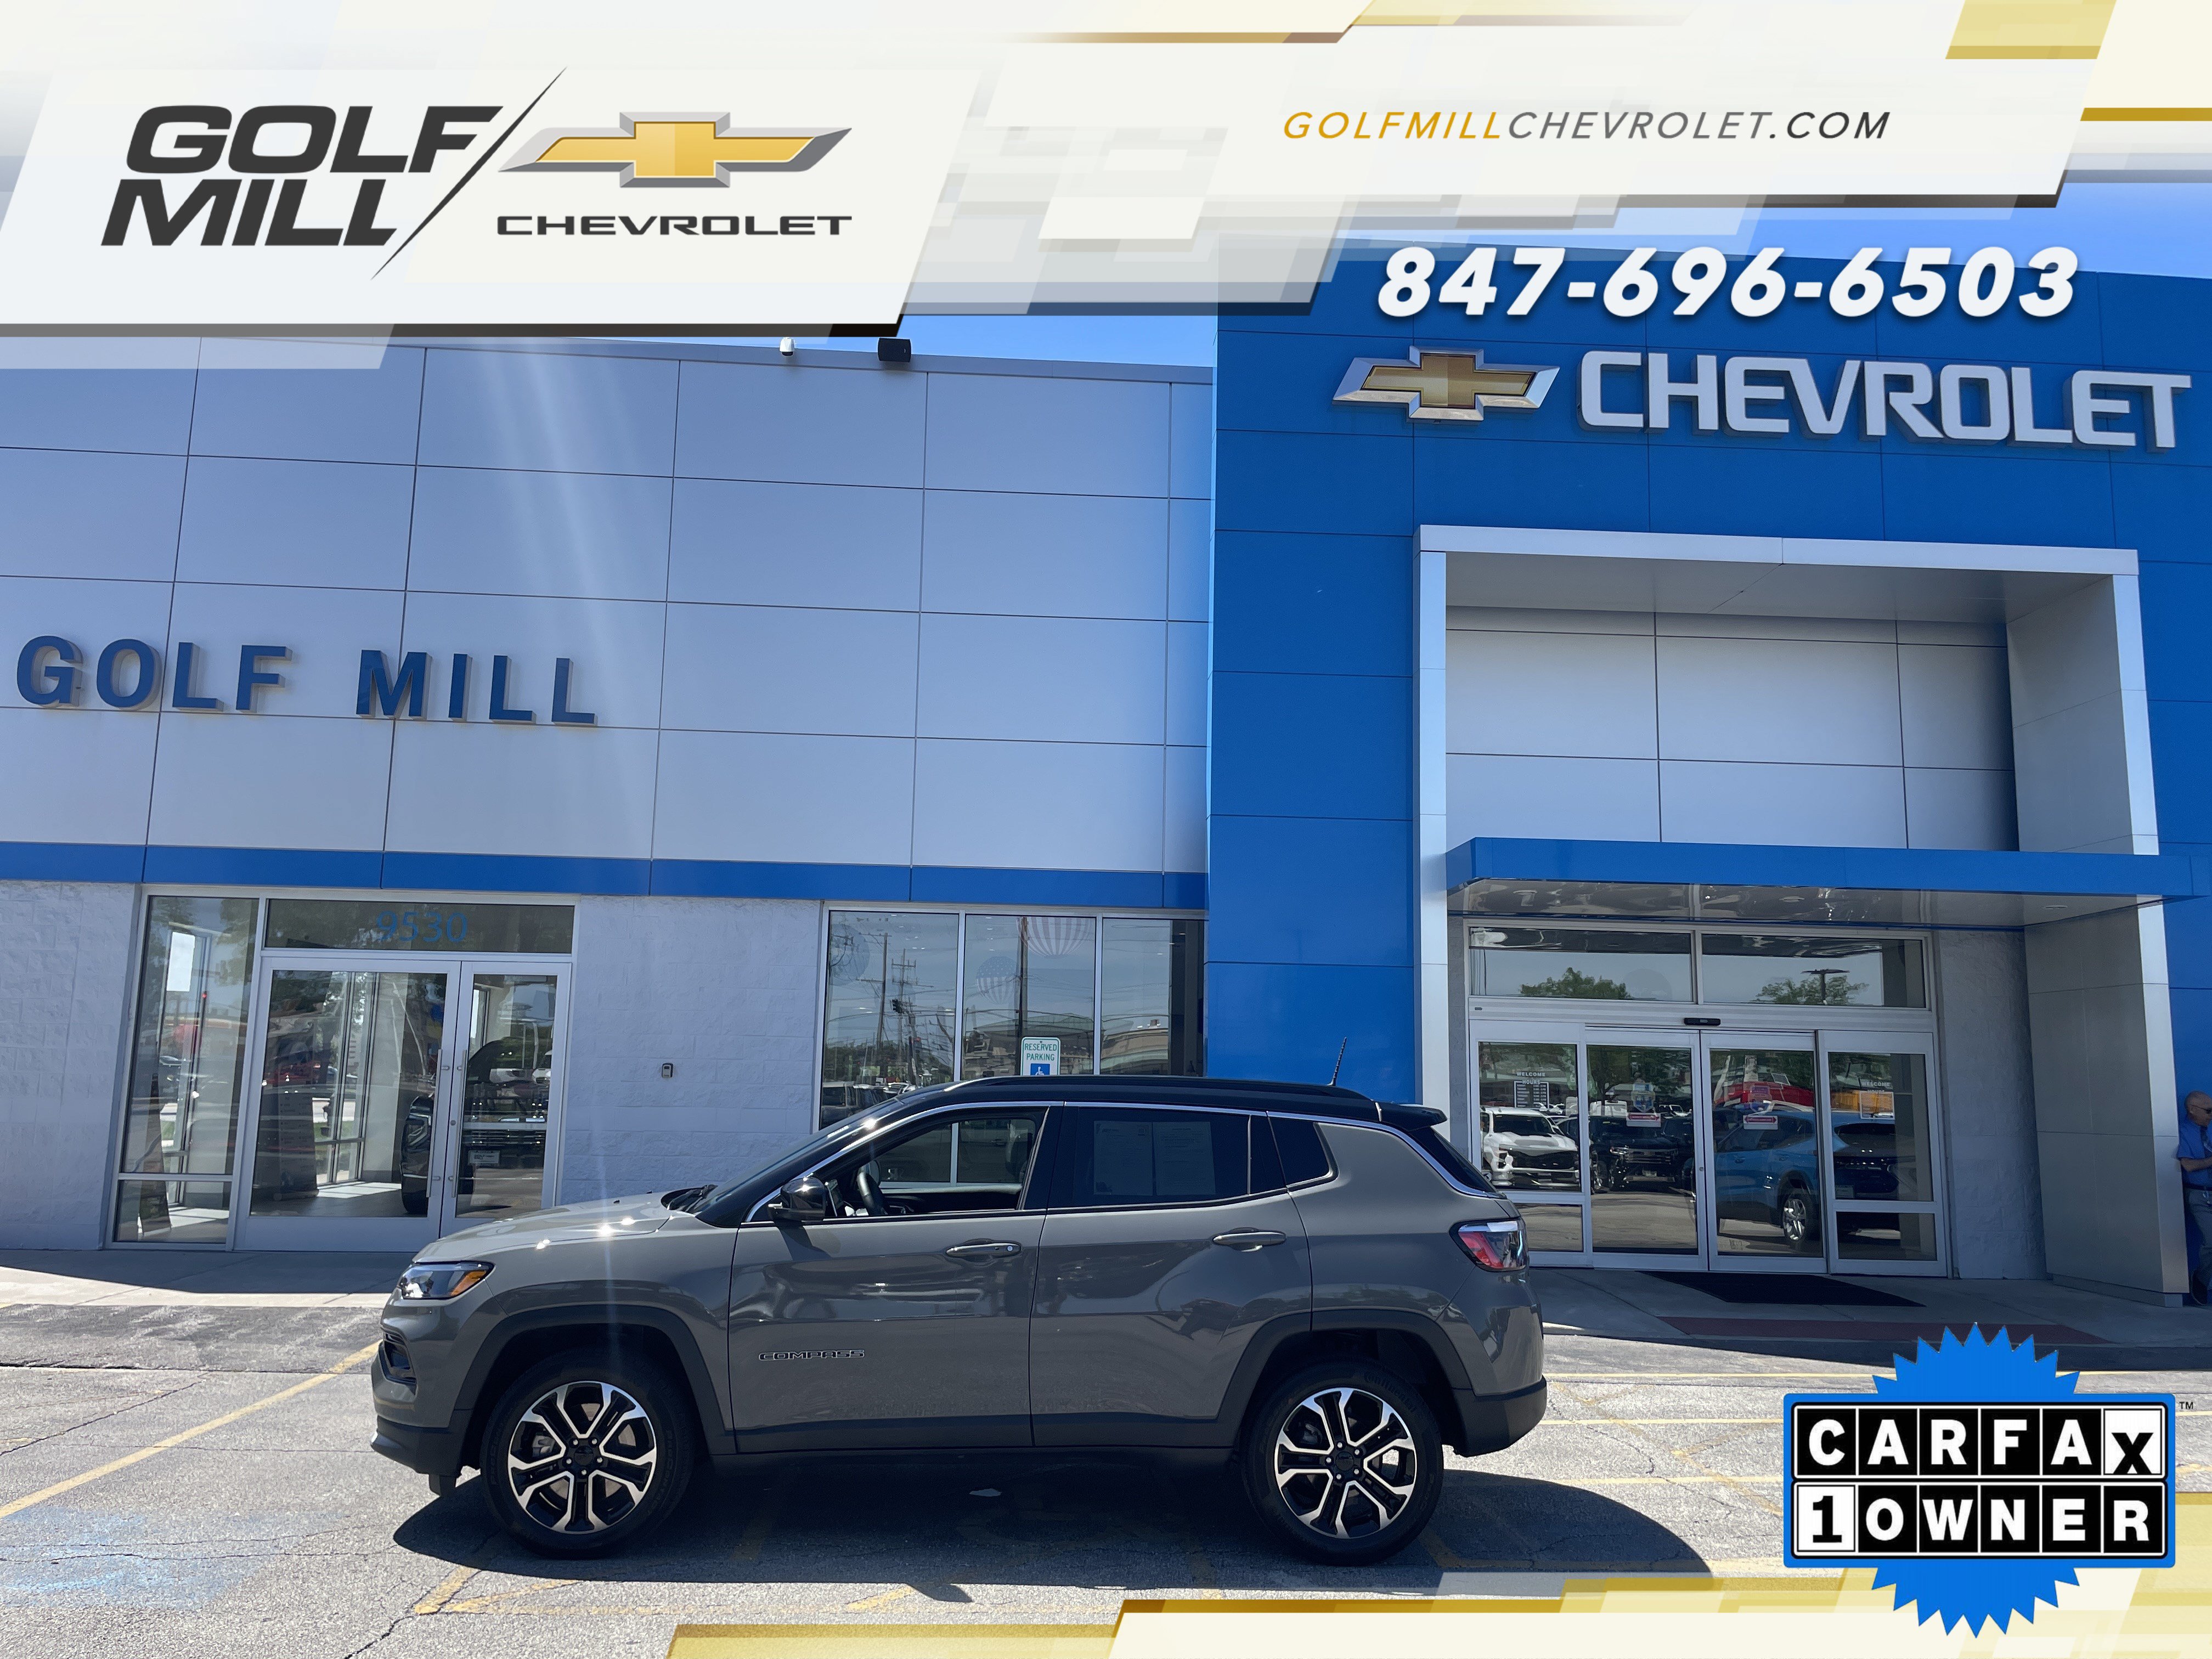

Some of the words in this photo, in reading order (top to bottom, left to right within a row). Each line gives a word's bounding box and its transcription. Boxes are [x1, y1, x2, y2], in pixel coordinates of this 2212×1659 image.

[1577, 349, 2192, 453] CHEVROLET
[16, 635, 292, 713] GOLF
[356, 650, 599, 726] MILL
[376, 910, 468, 943] 9530
[1024, 1043, 1057, 1051] RESERVED
[1026, 1053, 1055, 1061] PARKING
[758, 1350, 865, 1361] COMPASS
